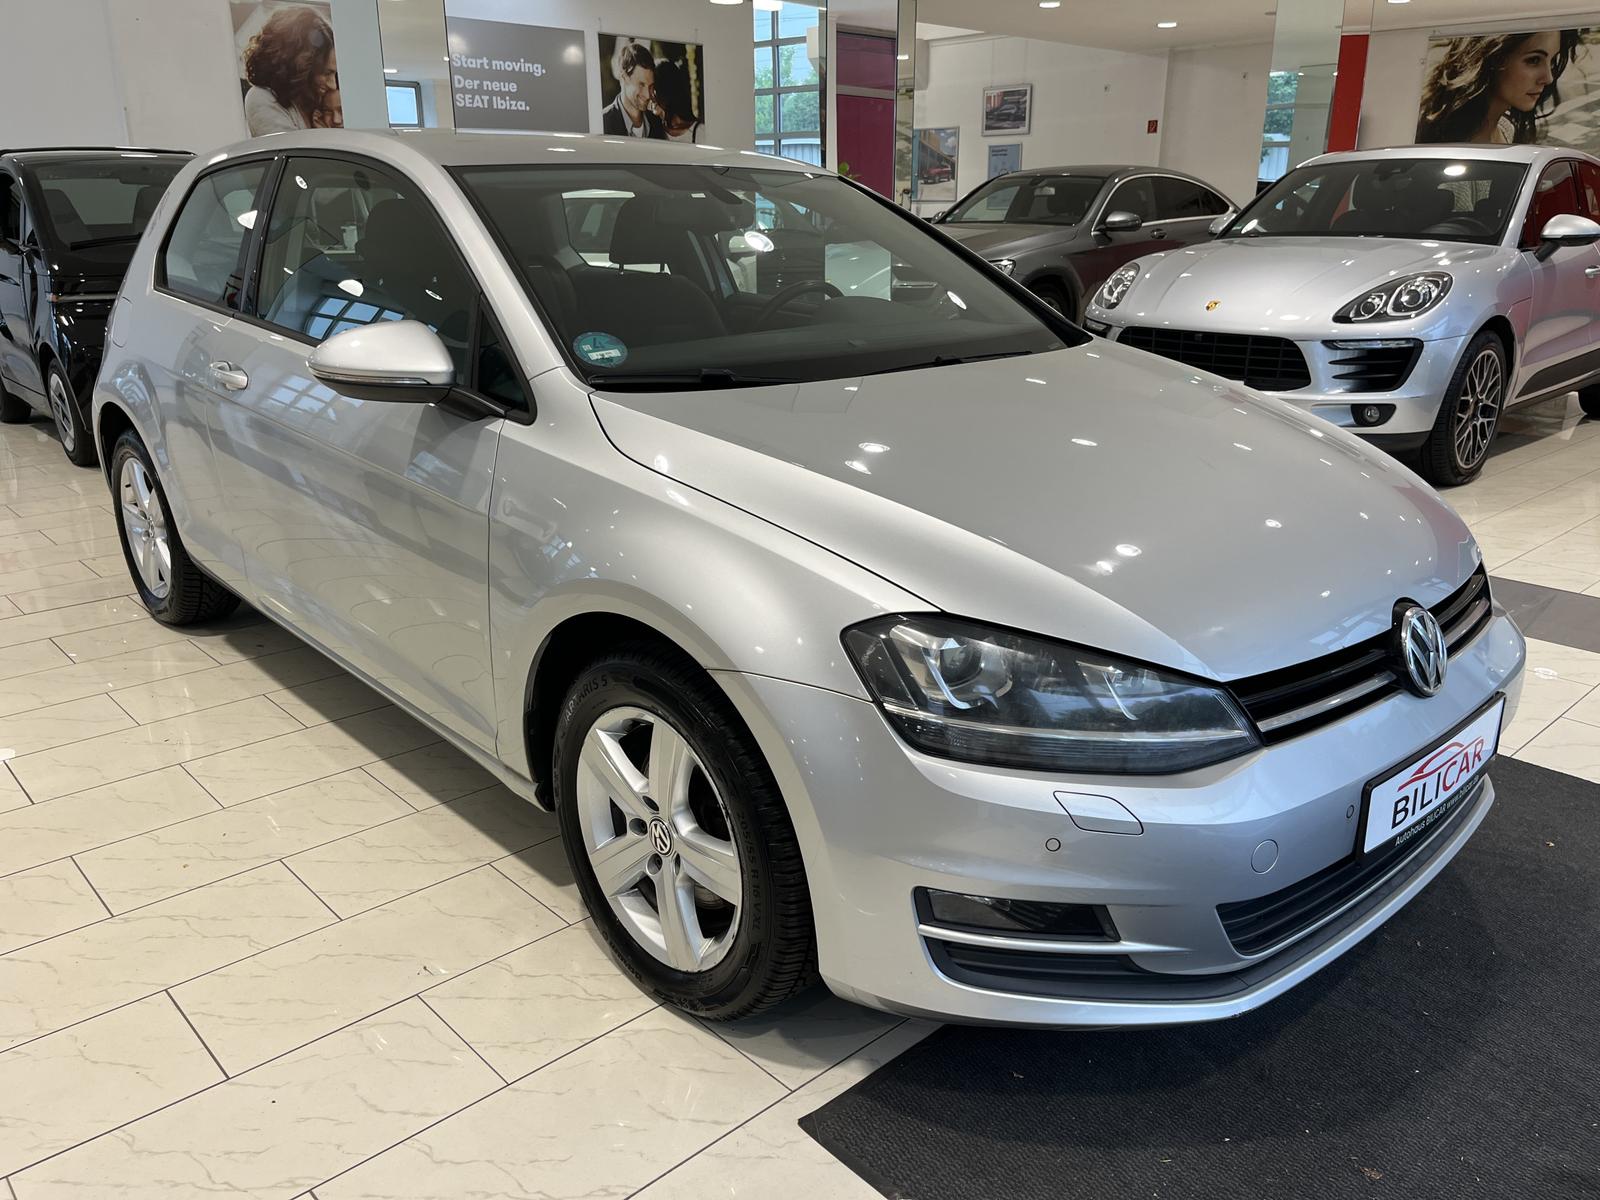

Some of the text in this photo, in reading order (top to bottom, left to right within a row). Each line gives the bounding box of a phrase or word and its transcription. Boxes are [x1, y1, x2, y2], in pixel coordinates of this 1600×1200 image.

[452, 53, 546, 76] Start moving.
[454, 75, 517, 92] Der neue
[456, 93, 530, 111] SEAT Ibiza.
[1391, 738, 1485, 830] BILICAR
[1395, 819, 1426, 846] Autohaus
[1426, 803, 1447, 826] BILICAR
